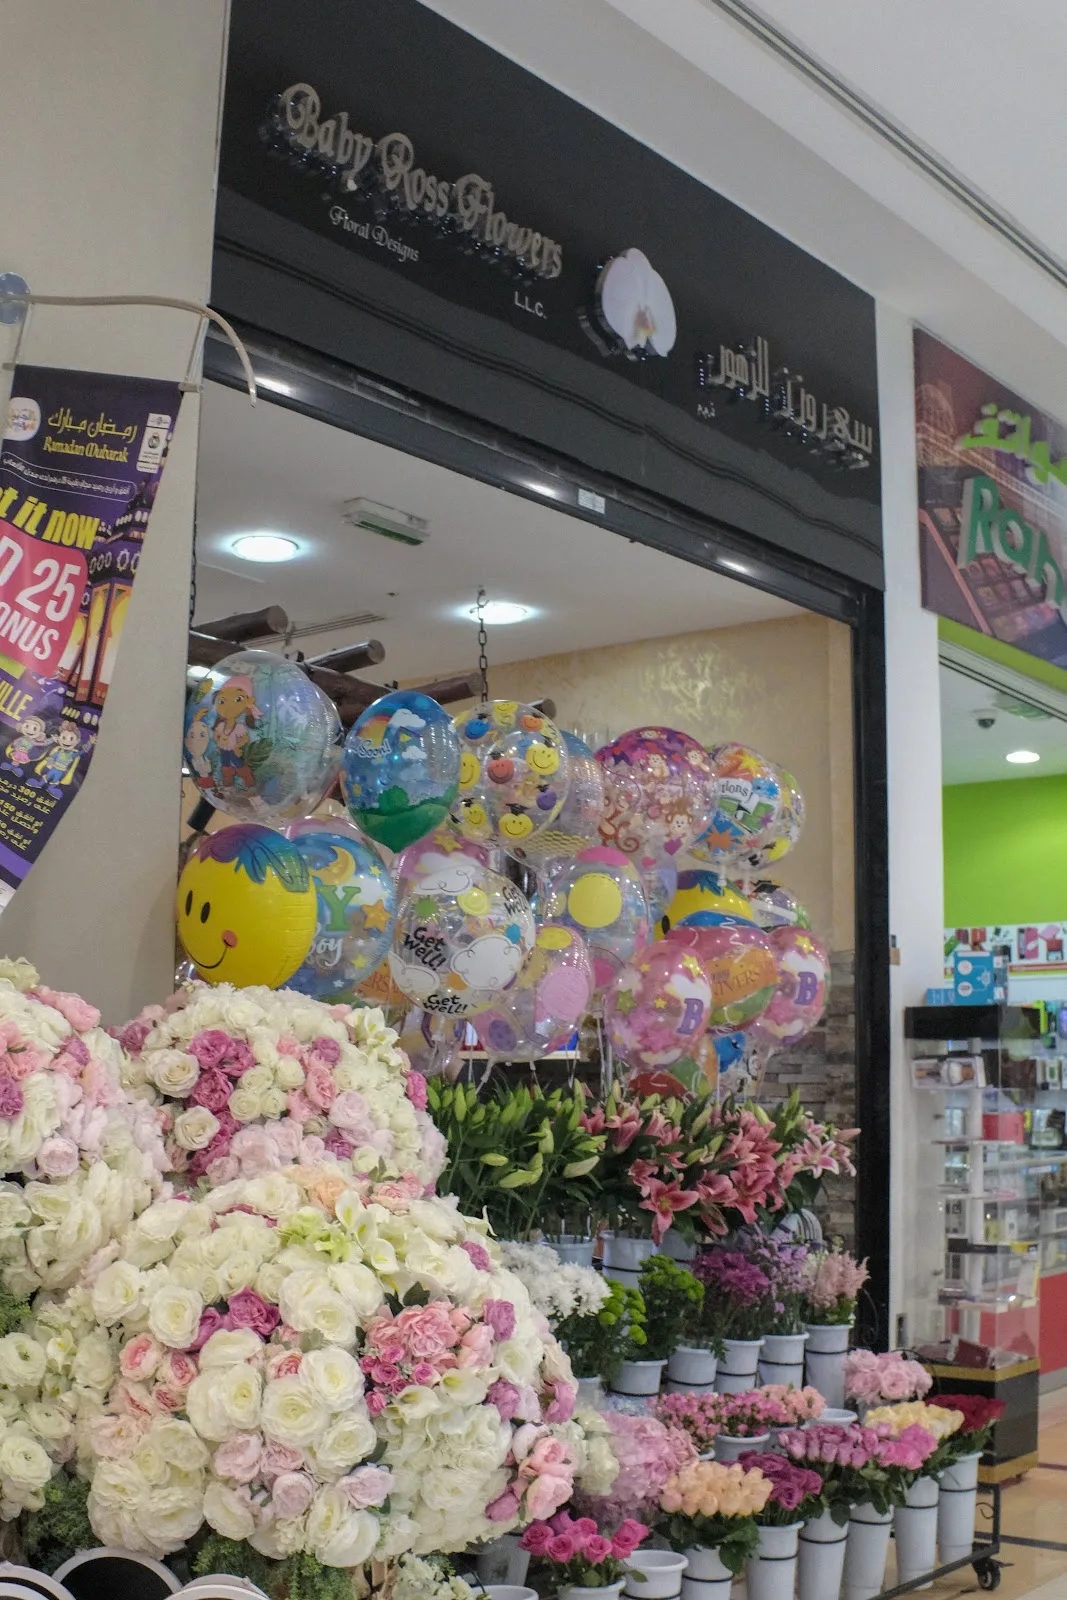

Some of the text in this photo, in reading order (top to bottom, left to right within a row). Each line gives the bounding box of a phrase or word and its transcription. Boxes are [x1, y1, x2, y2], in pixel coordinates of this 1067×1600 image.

[279, 83, 562, 279] Baby Ross Flowers
[329, 205, 419, 262] Floral Designs
[48, 407, 88, 433] مبارك
[87, 412, 138, 443] رمضان
[42, 436, 85, 455] Ramadan
[85, 442, 129, 463] Mubarak
[12, 495, 48, 535] it
[41, 509, 101, 550] now
[15, 557, 81, 622] 25
[18, 785, 37, 798] 300
[413, 926, 446, 952] Get
[427, 993, 461, 1006] Get
